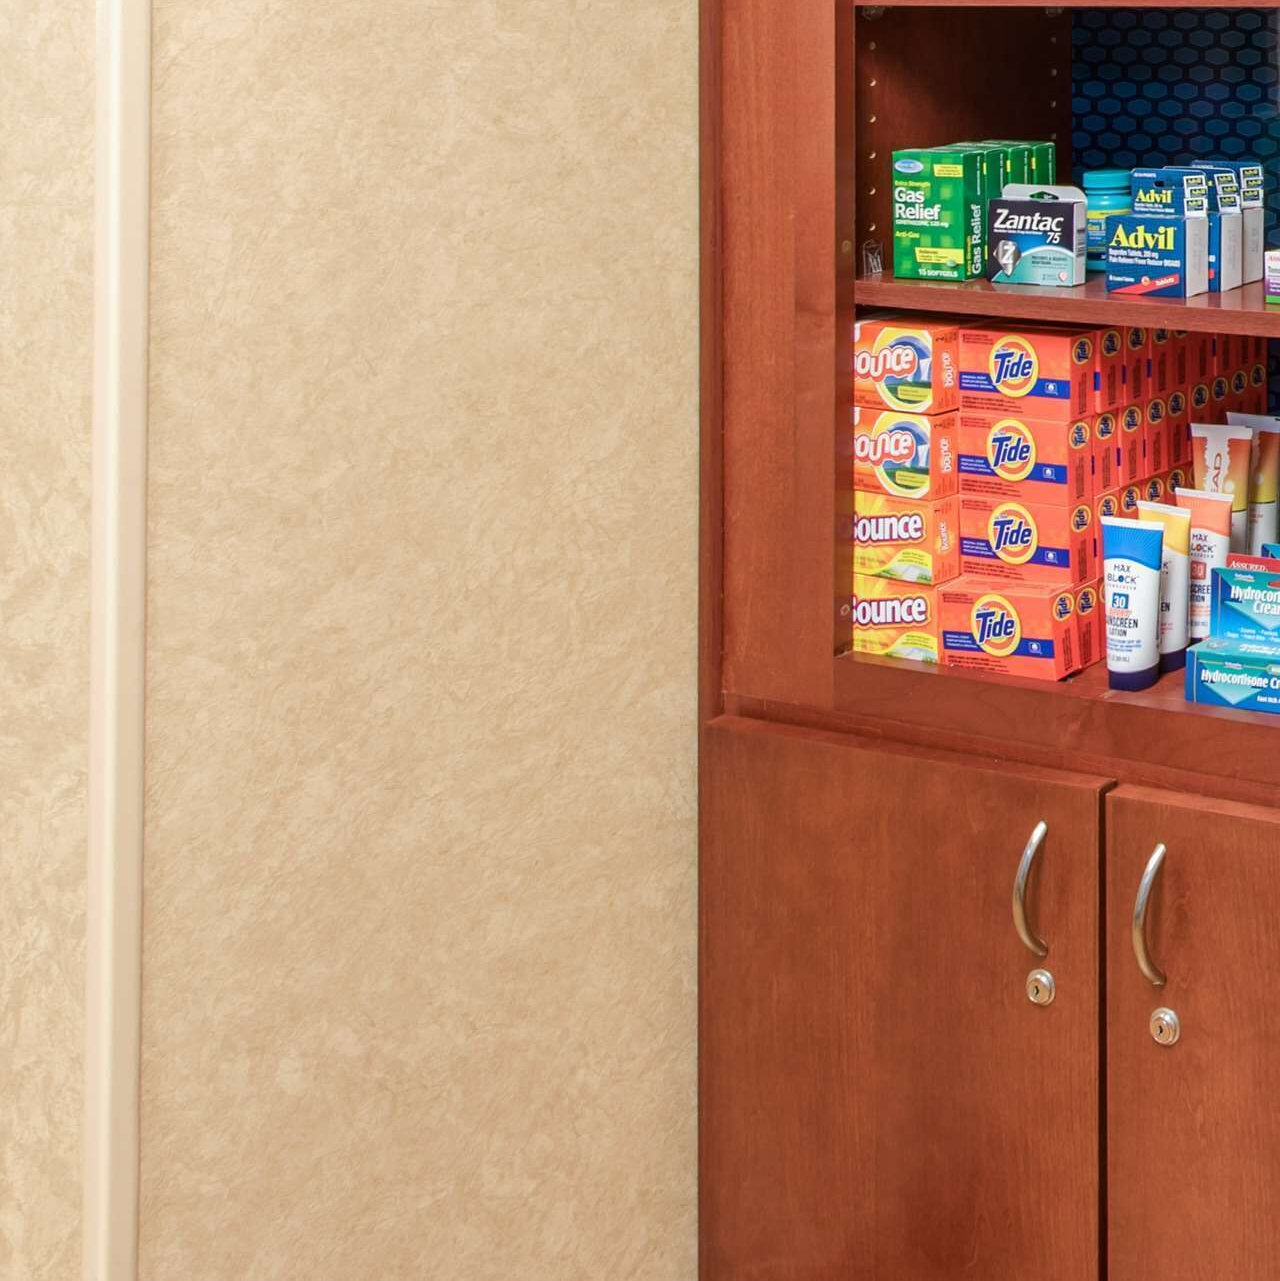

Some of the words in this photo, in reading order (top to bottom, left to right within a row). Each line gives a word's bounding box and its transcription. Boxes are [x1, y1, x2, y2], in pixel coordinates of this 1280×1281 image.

[895, 187, 925, 203] Gas
[1135, 189, 1172, 204] Advil
[896, 204, 941, 220] Relief
[993, 208, 1064, 232] Zantac
[971, 204, 981, 244] Relief
[1045, 232, 1062, 244] 75
[1109, 224, 1175, 250] Advil
[972, 246, 981, 275] Gas
[994, 351, 1034, 384] Tide
[992, 435, 1032, 468] Tide
[994, 518, 1033, 551] Tide
[1192, 533, 1208, 541] MAX
[1107, 573, 1137, 584] BLOCK
[1114, 564, 1131, 573] MAX
[1113, 596, 1126, 608] 30
[976, 610, 1016, 644] Tide
[1201, 669, 1269, 689] Hydrocortisone
